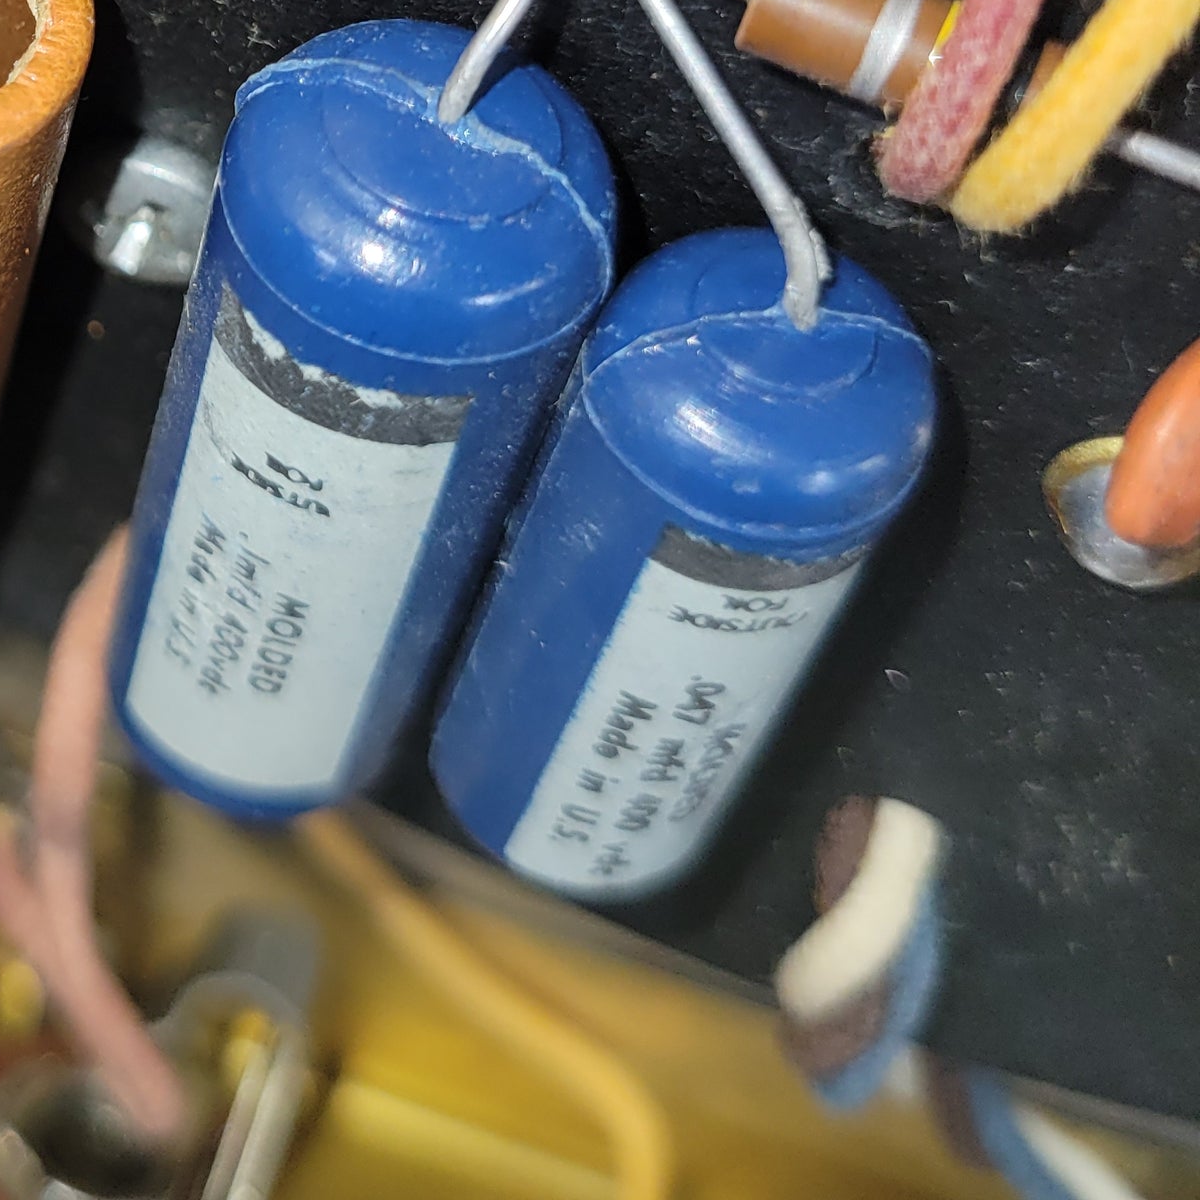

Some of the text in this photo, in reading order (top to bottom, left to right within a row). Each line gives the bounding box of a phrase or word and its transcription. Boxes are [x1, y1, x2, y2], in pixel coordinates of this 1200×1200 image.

[186, 512, 227, 585] Made
[248, 592, 310, 696] MOLDED
[594, 689, 659, 760] Made
[575, 768, 620, 795] in
